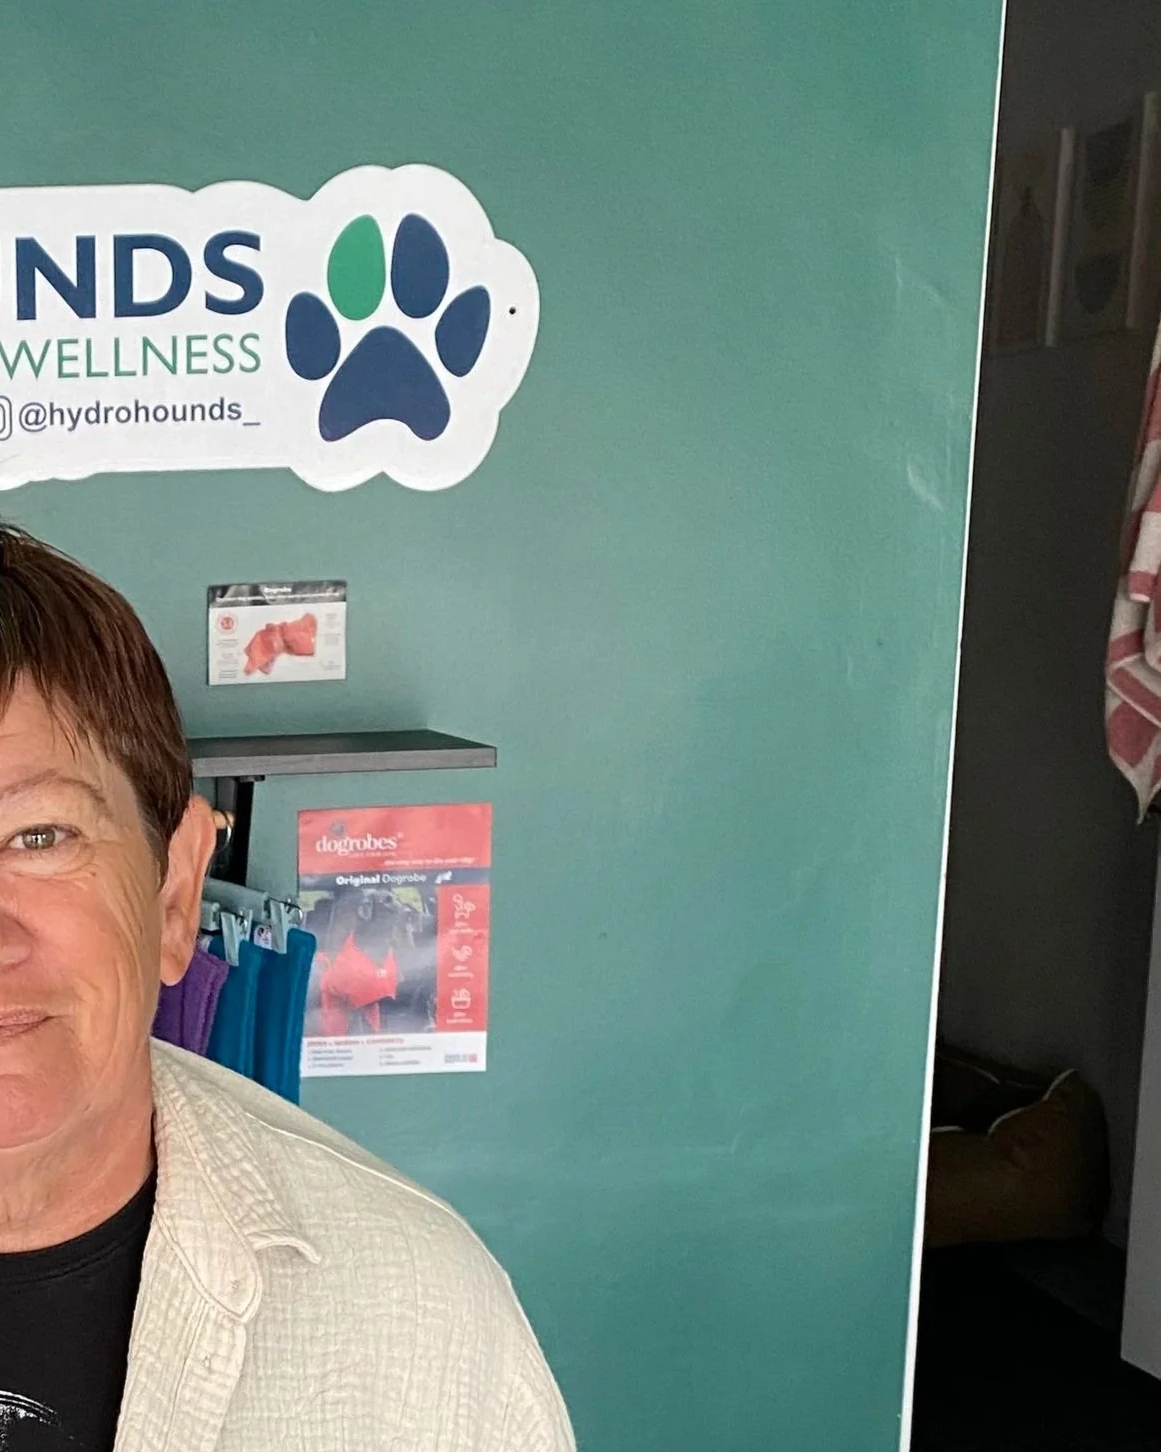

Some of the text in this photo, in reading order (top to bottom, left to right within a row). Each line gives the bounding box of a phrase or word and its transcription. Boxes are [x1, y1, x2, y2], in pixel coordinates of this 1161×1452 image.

[18, 397, 261, 433] @hydrohounds_
[336, 873, 427, 887] Original Dogrobe
